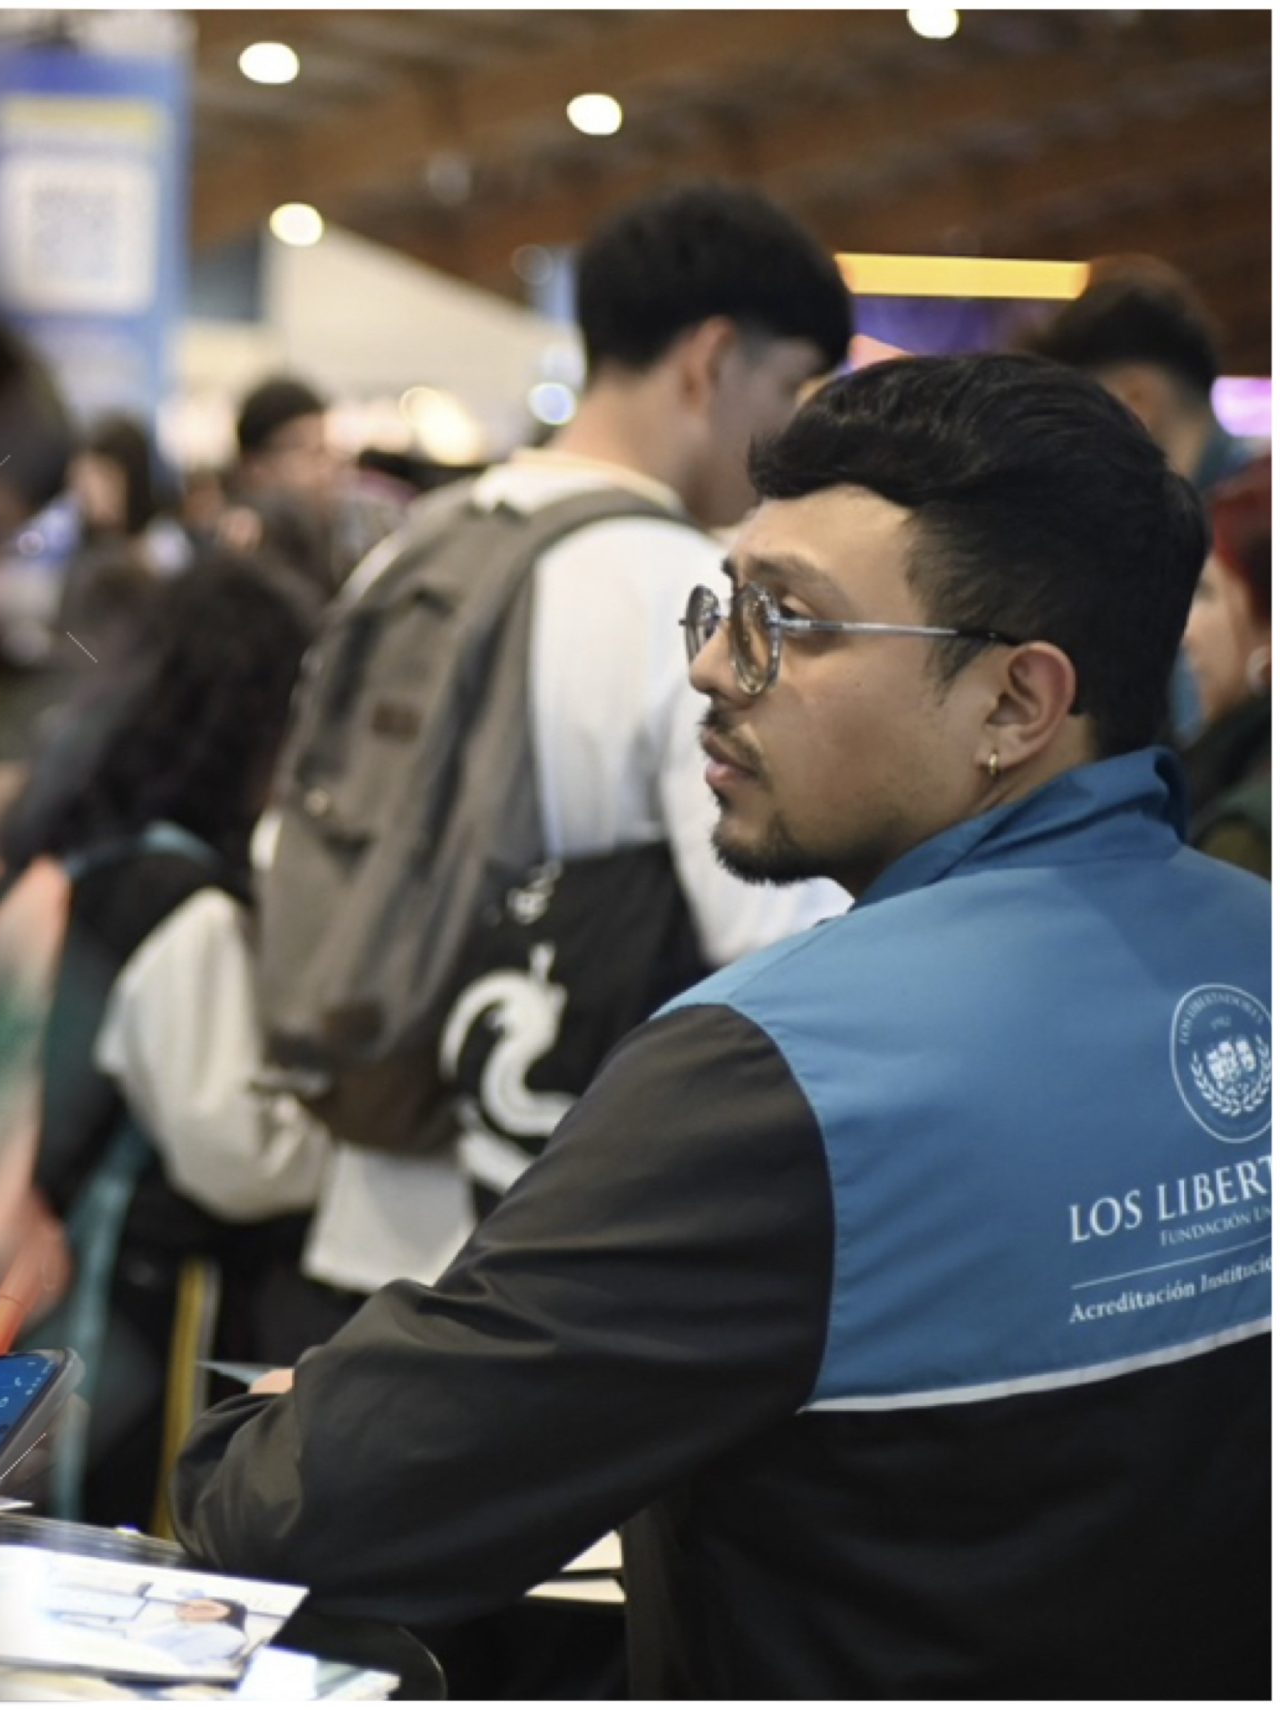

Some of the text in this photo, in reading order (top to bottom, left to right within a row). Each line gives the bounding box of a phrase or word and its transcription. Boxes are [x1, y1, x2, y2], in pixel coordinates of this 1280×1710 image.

[1069, 1189, 1143, 1243] LOS
[1160, 1212, 1252, 1246] FUNDACIÓN
[1069, 1279, 1196, 1324] Acreditación
